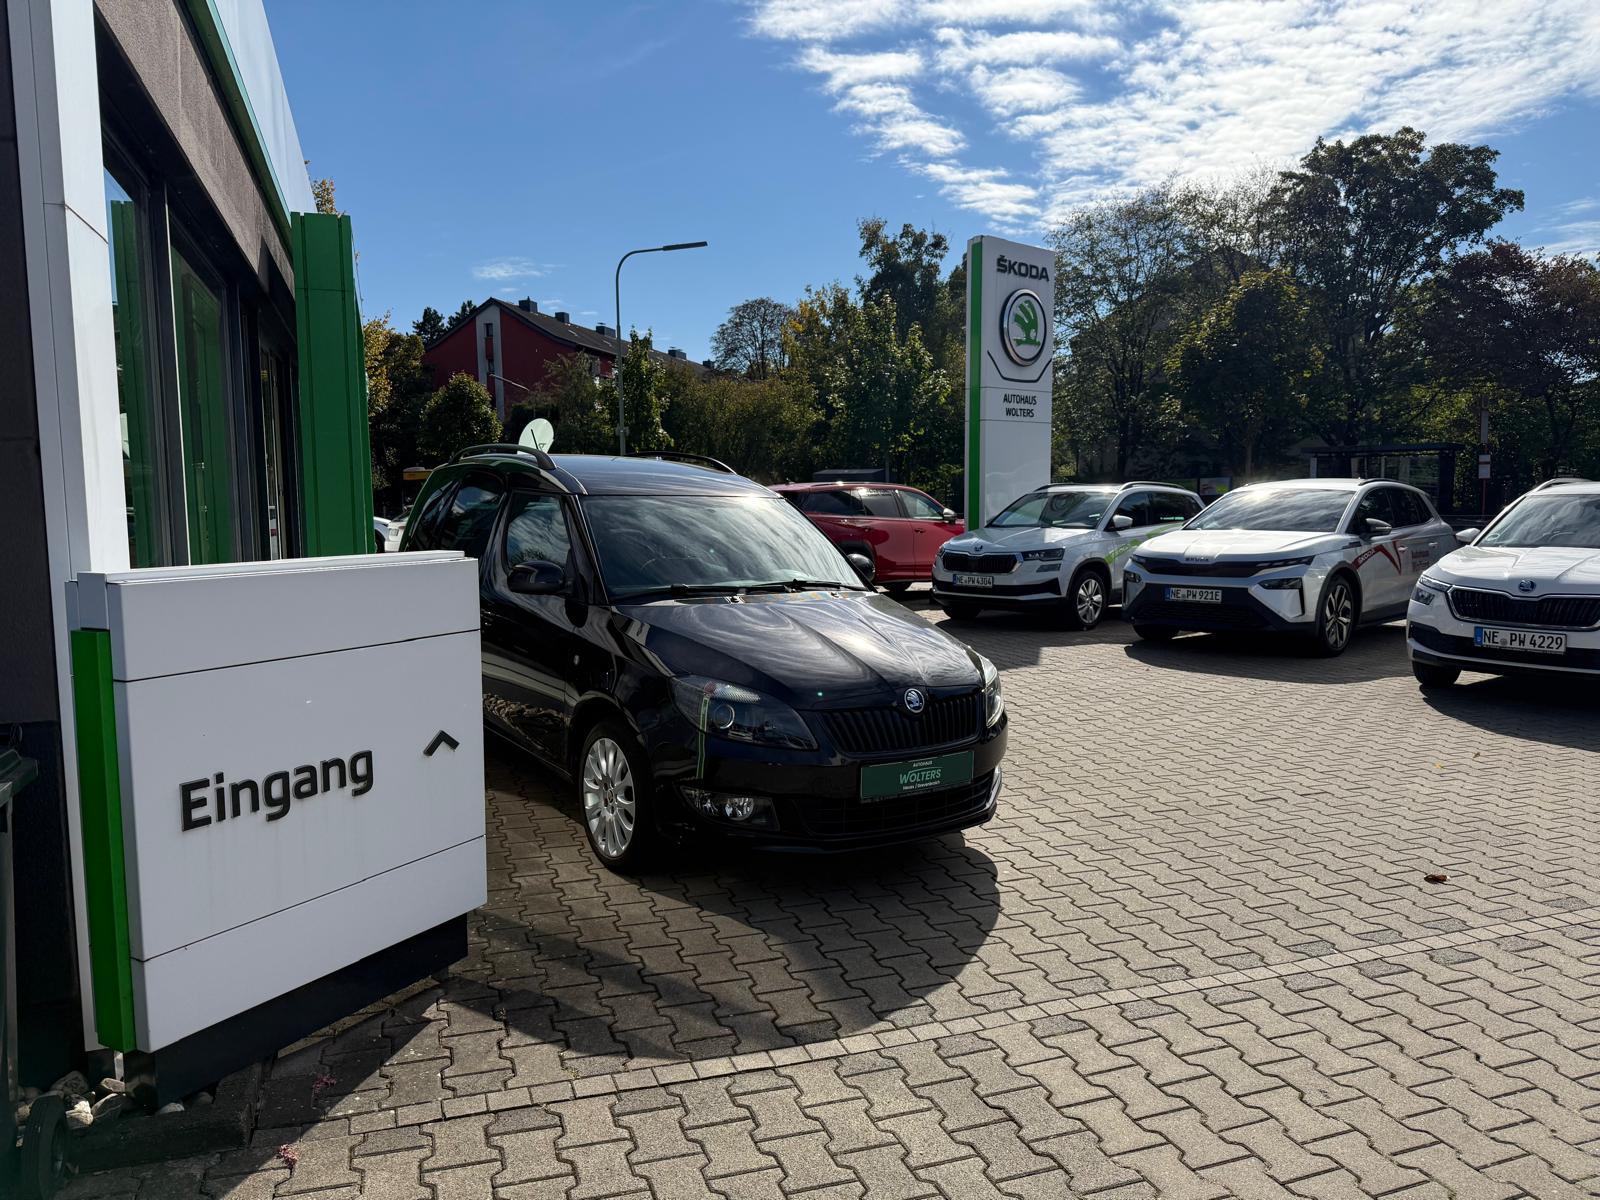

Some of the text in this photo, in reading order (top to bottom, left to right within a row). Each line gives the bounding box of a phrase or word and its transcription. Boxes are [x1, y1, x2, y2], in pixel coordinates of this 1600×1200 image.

[996, 254, 1050, 282] ŠKODA
[1003, 393, 1037, 405] AUTOHAUS
[1005, 407, 1035, 418] WOLTERS
[976, 577, 992, 586] 4304
[1170, 589, 1220, 601] NE PW 921E
[1483, 630, 1563, 650] NE PW 4229
[899, 768, 942, 785] WOLTERS
[179, 750, 373, 832] Eingang
